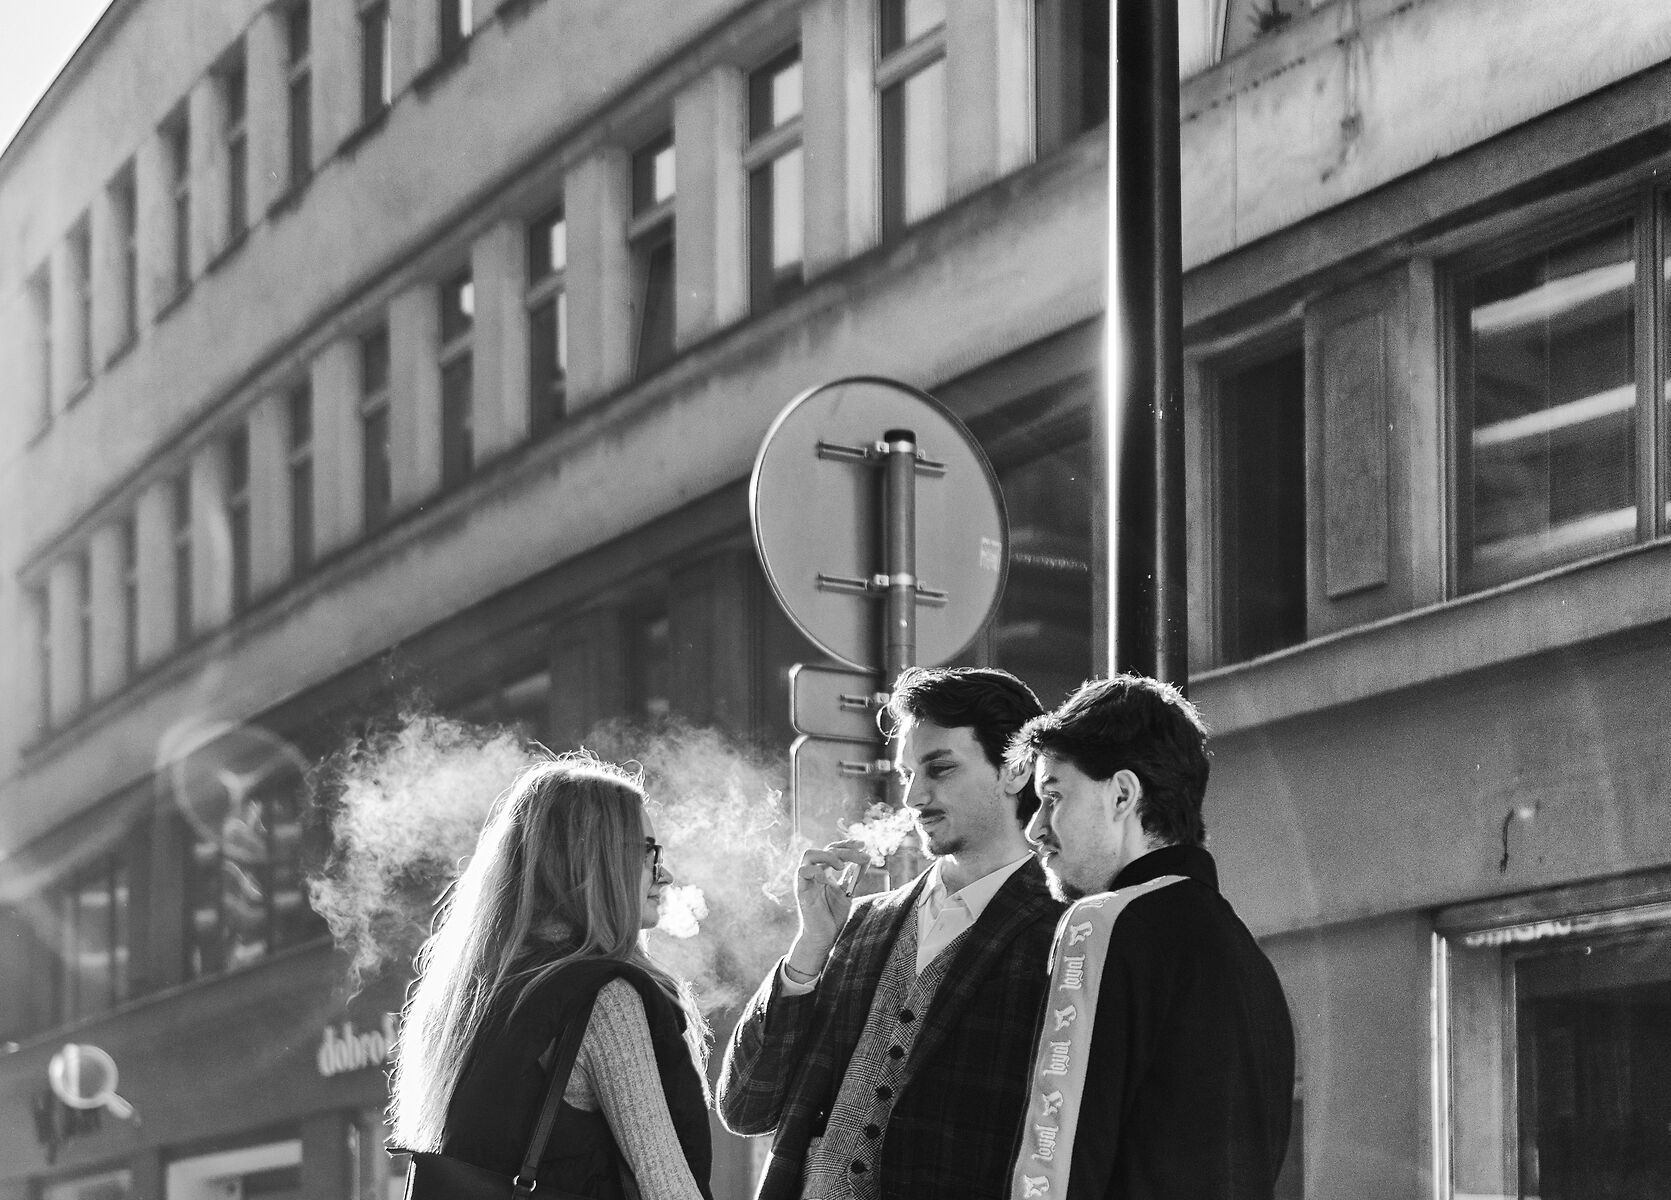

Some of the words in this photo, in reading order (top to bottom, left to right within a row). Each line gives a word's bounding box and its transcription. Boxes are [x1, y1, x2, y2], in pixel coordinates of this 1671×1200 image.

[1060, 954, 1085, 991] loyal
[1043, 1040, 1071, 1076] loyal
[1032, 1124, 1059, 1161] loyal
